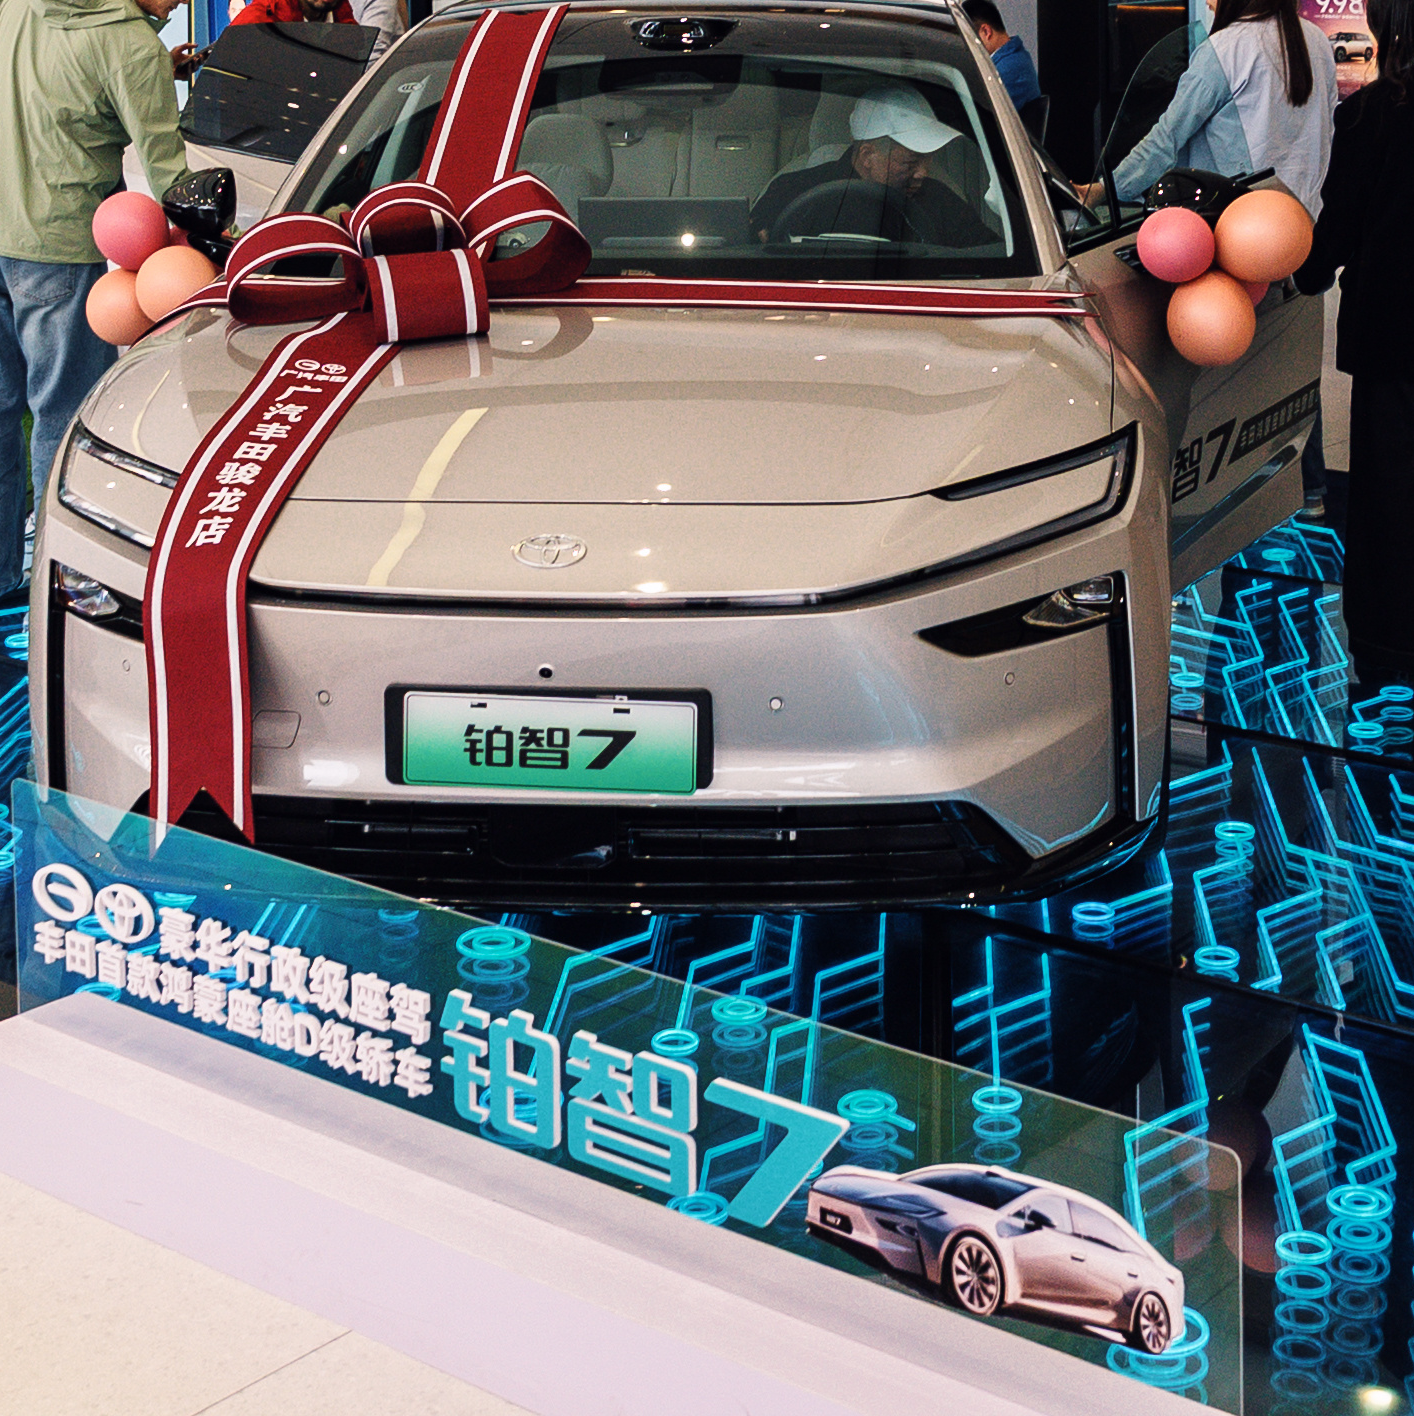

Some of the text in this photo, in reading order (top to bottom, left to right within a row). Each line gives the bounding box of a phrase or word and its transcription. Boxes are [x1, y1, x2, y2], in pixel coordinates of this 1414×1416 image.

[185, 385, 323, 549] 广汽丰田骏龙店
[463, 723, 638, 771] 铂智7
[33, 919, 434, 1100] 丰田首款鸿蒙座舱D级轿车
[158, 906, 431, 1047] 豪华行政级座驾
[440, 987, 851, 1228] 铂智7
